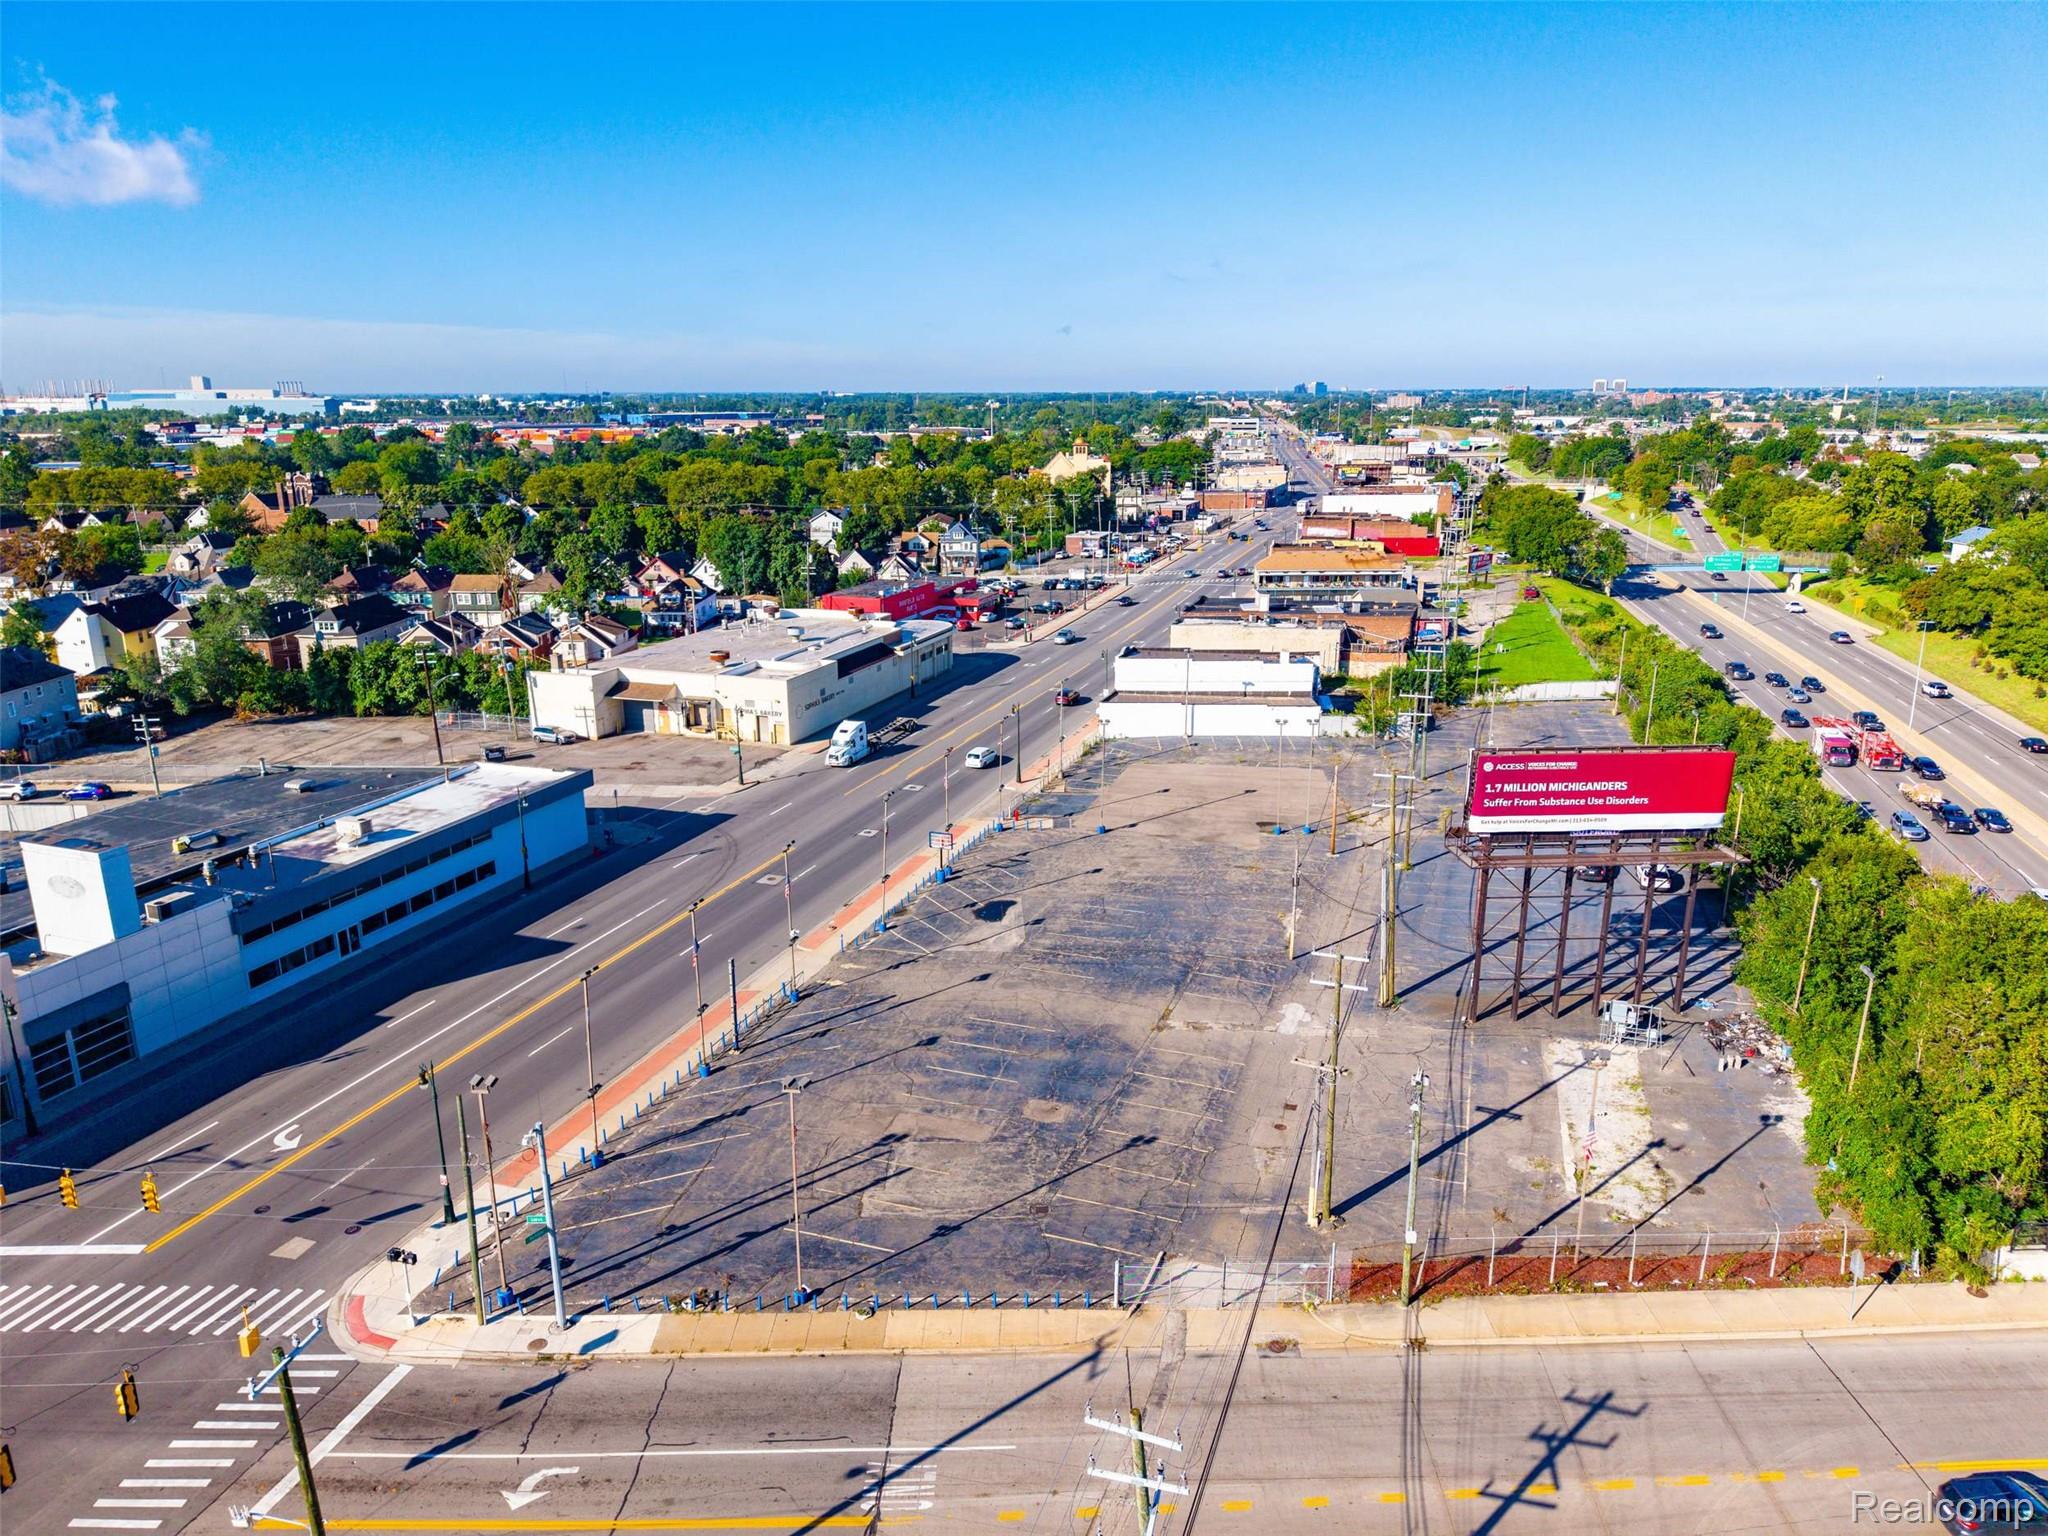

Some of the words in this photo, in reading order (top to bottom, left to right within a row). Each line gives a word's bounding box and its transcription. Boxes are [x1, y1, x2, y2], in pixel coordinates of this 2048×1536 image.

[1485, 783, 1502, 793] 1.7
[1503, 783, 1547, 792] MILLION
[1548, 781, 1628, 792] MICHIGANDERS
[1483, 798, 1512, 807] Suffer
[1514, 798, 1538, 807] From
[1539, 797, 1586, 806] Substance
[1587, 797, 1604, 805] Use
[1606, 796, 1649, 805] Disorders
